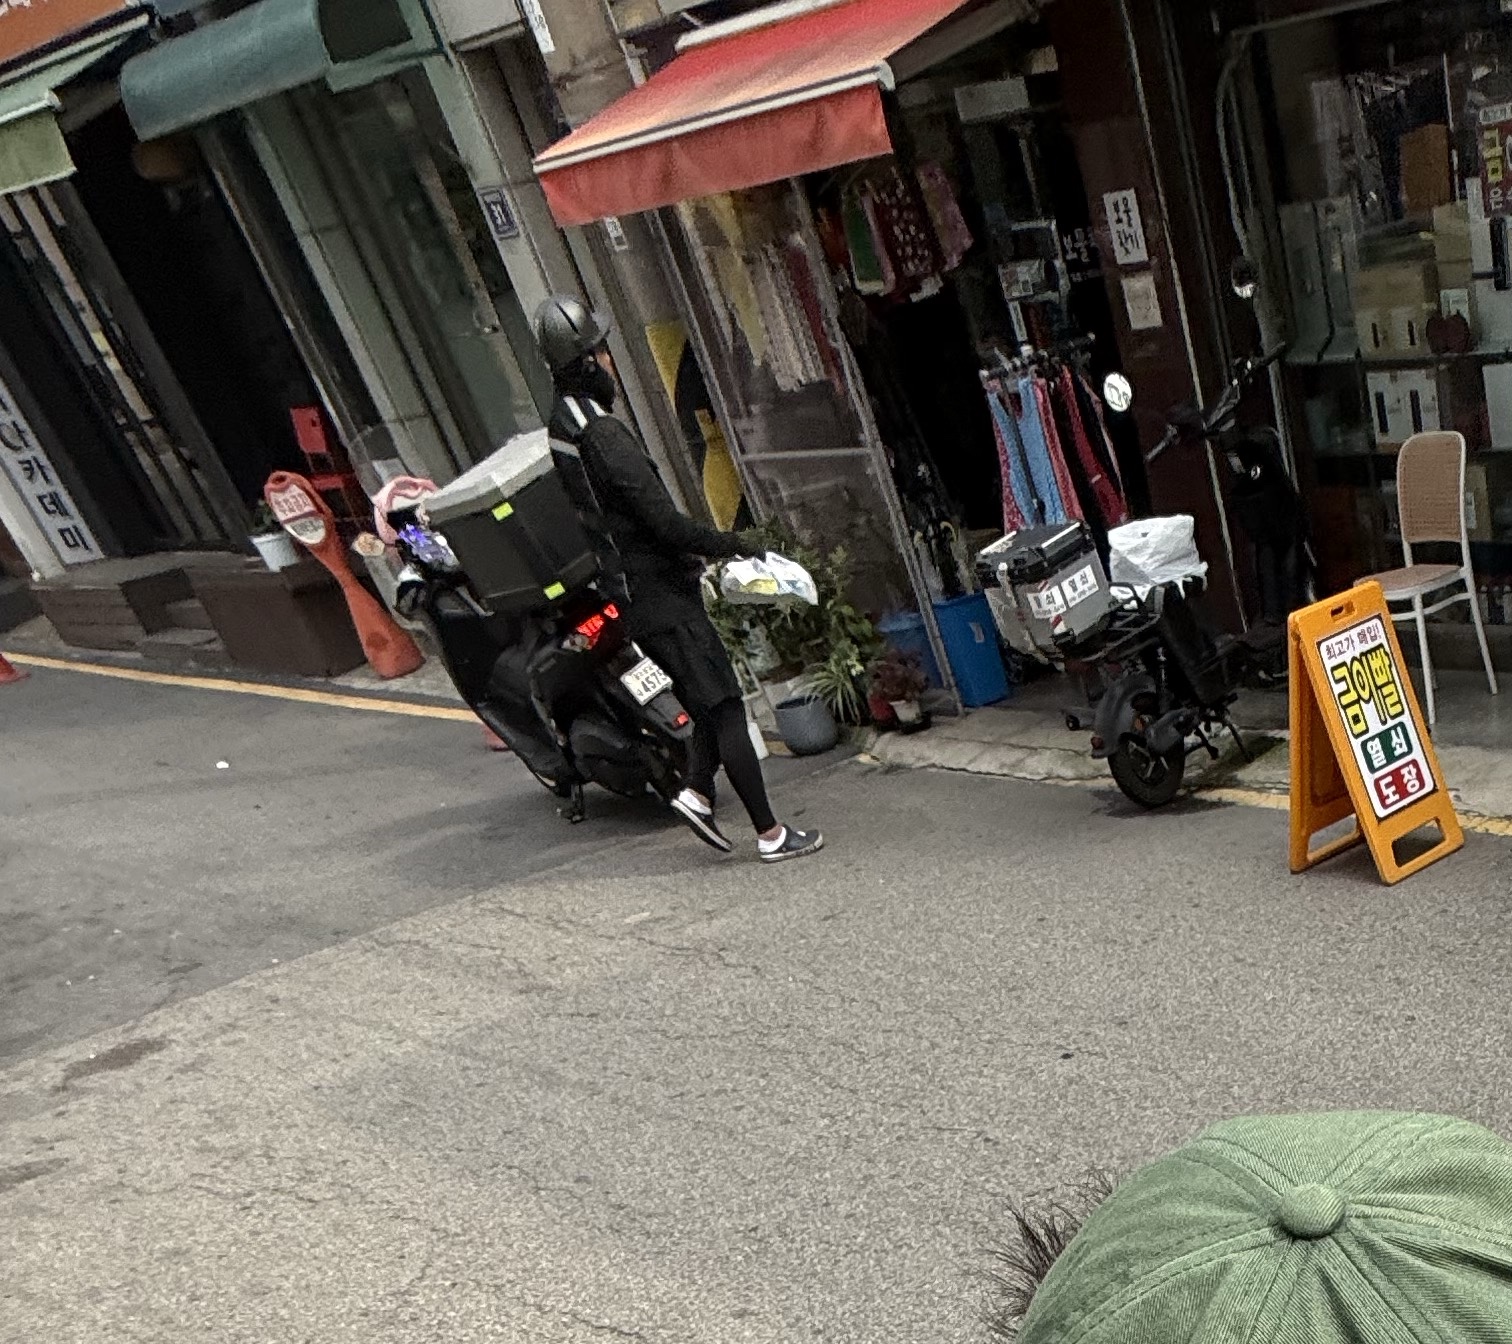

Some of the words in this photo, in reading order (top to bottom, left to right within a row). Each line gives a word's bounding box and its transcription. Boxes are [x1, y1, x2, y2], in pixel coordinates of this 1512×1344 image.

[0, 397, 92, 553] 아카데미
[1325, 633, 1355, 661] 최고가
[1330, 643, 1405, 740] 금이빨
[1366, 725, 1408, 769] 열쇠
[1379, 764, 1420, 804] 도장
